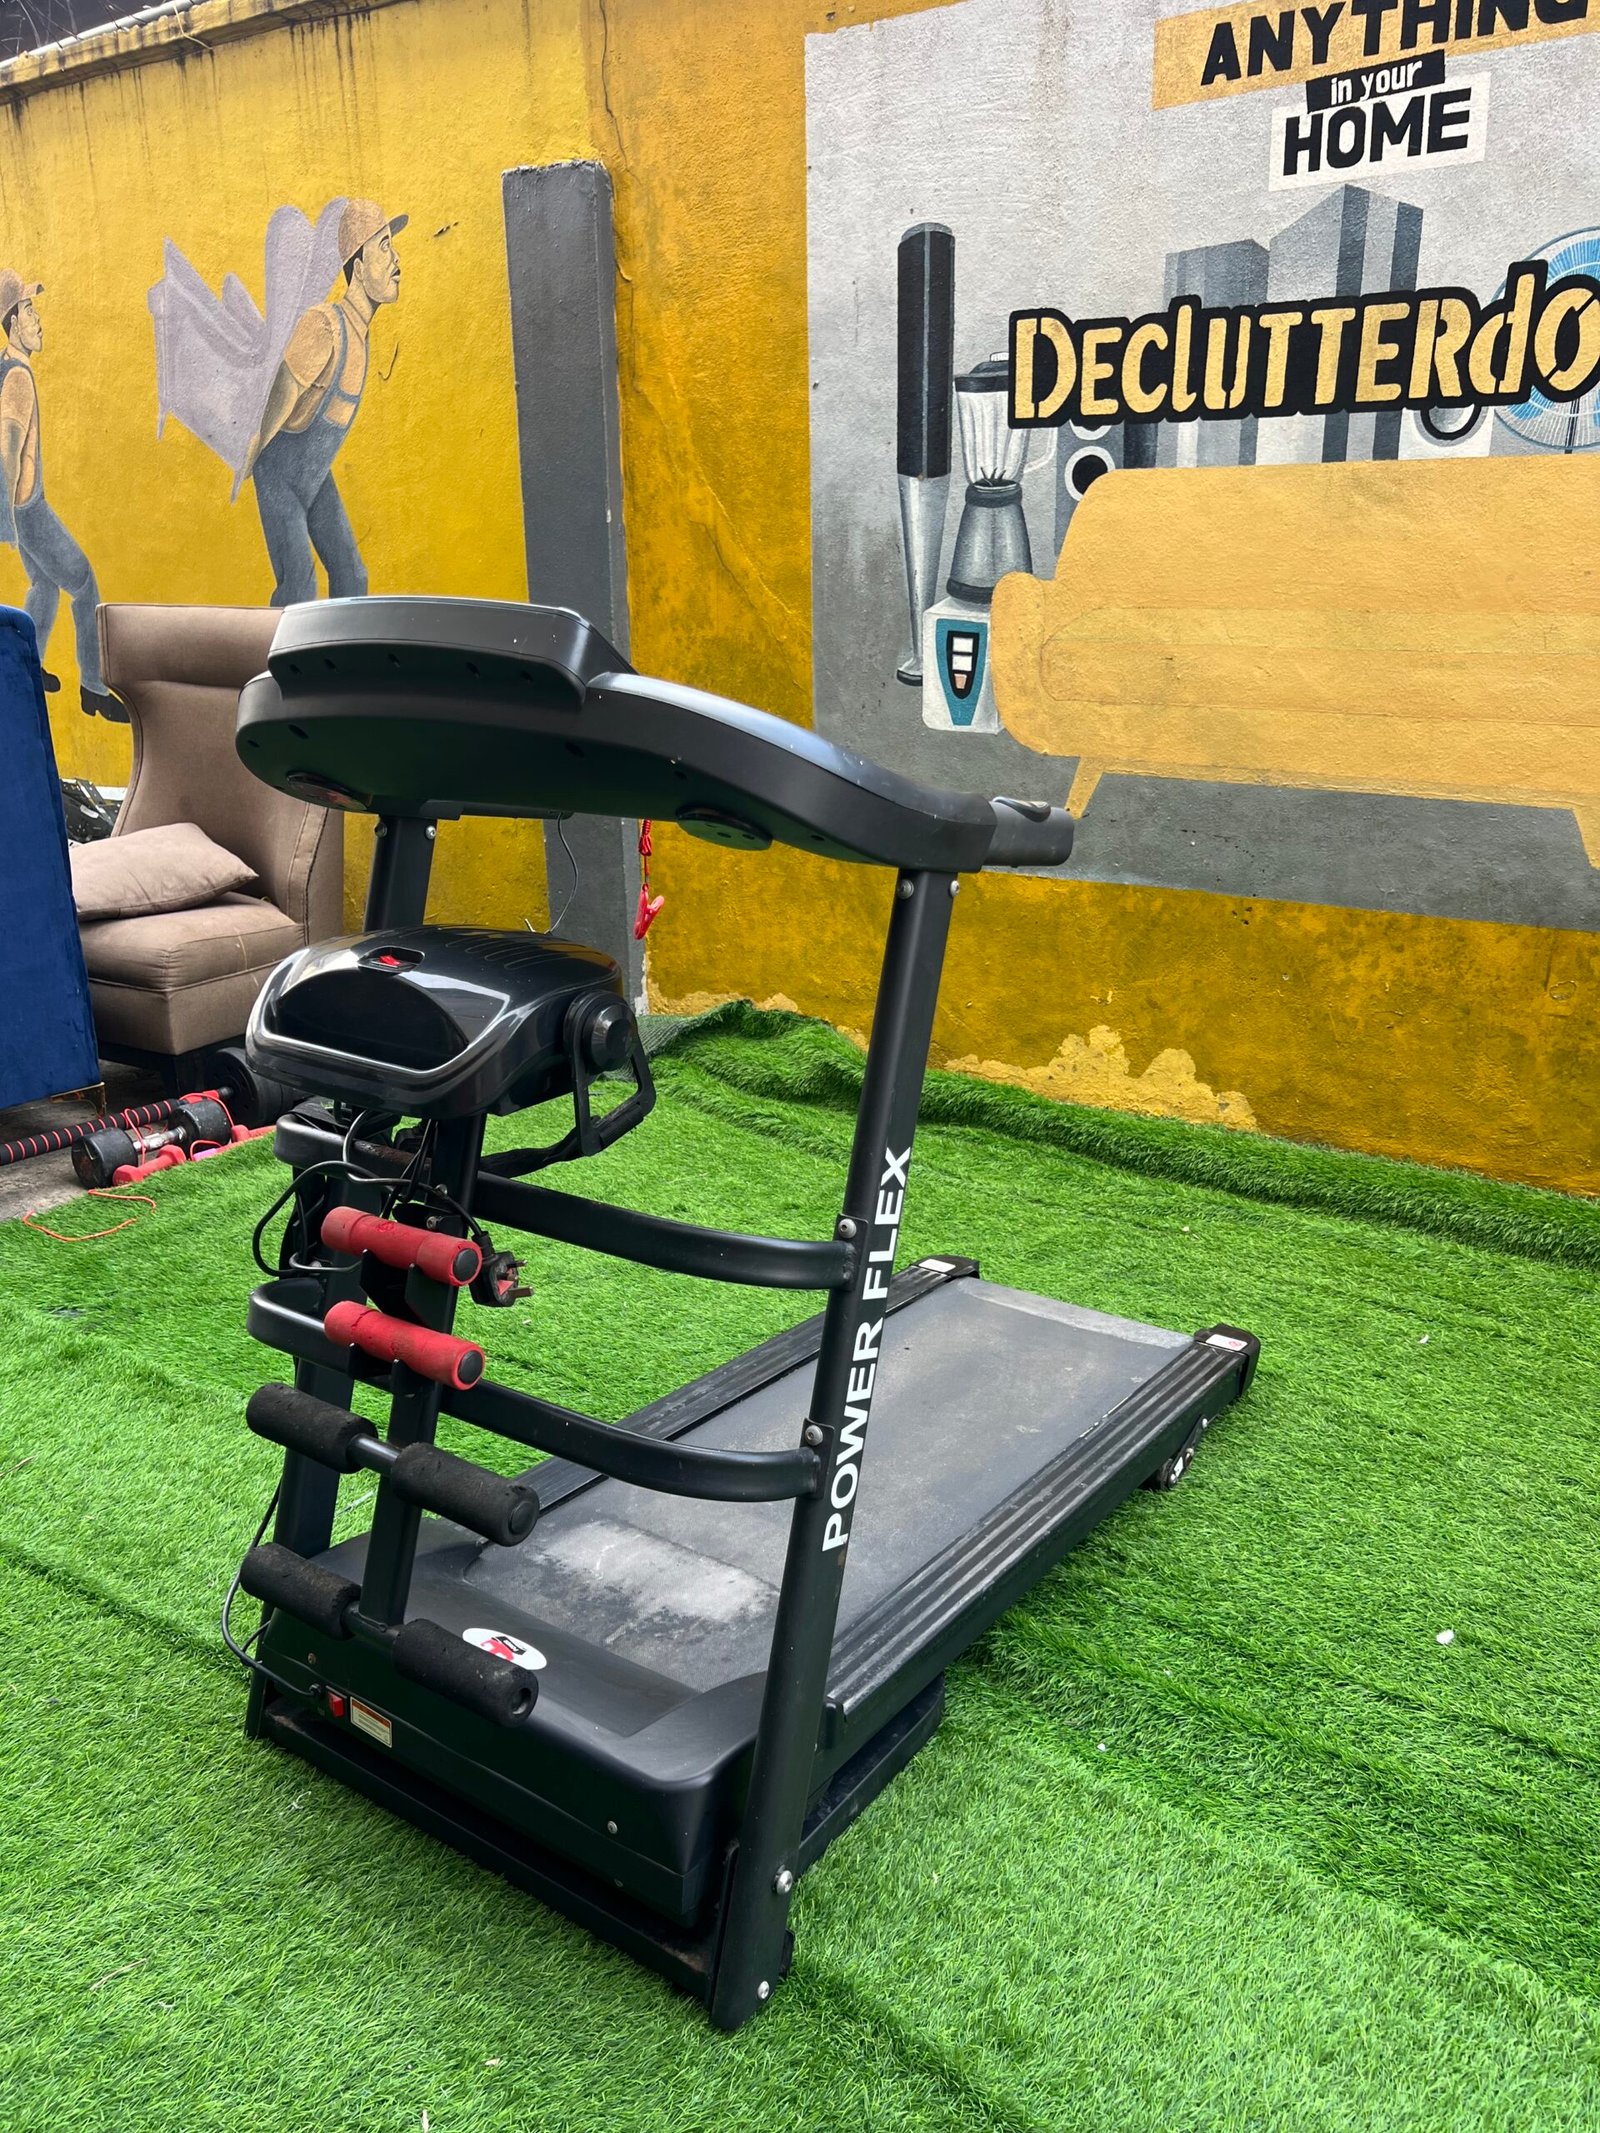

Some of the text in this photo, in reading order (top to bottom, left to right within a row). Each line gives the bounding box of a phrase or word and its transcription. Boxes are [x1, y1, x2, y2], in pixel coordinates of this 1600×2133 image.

[1330, 60, 1423, 105] in your
[1283, 88, 1472, 175] HOME
[822, 1146, 911, 1552] POWER FLEX
